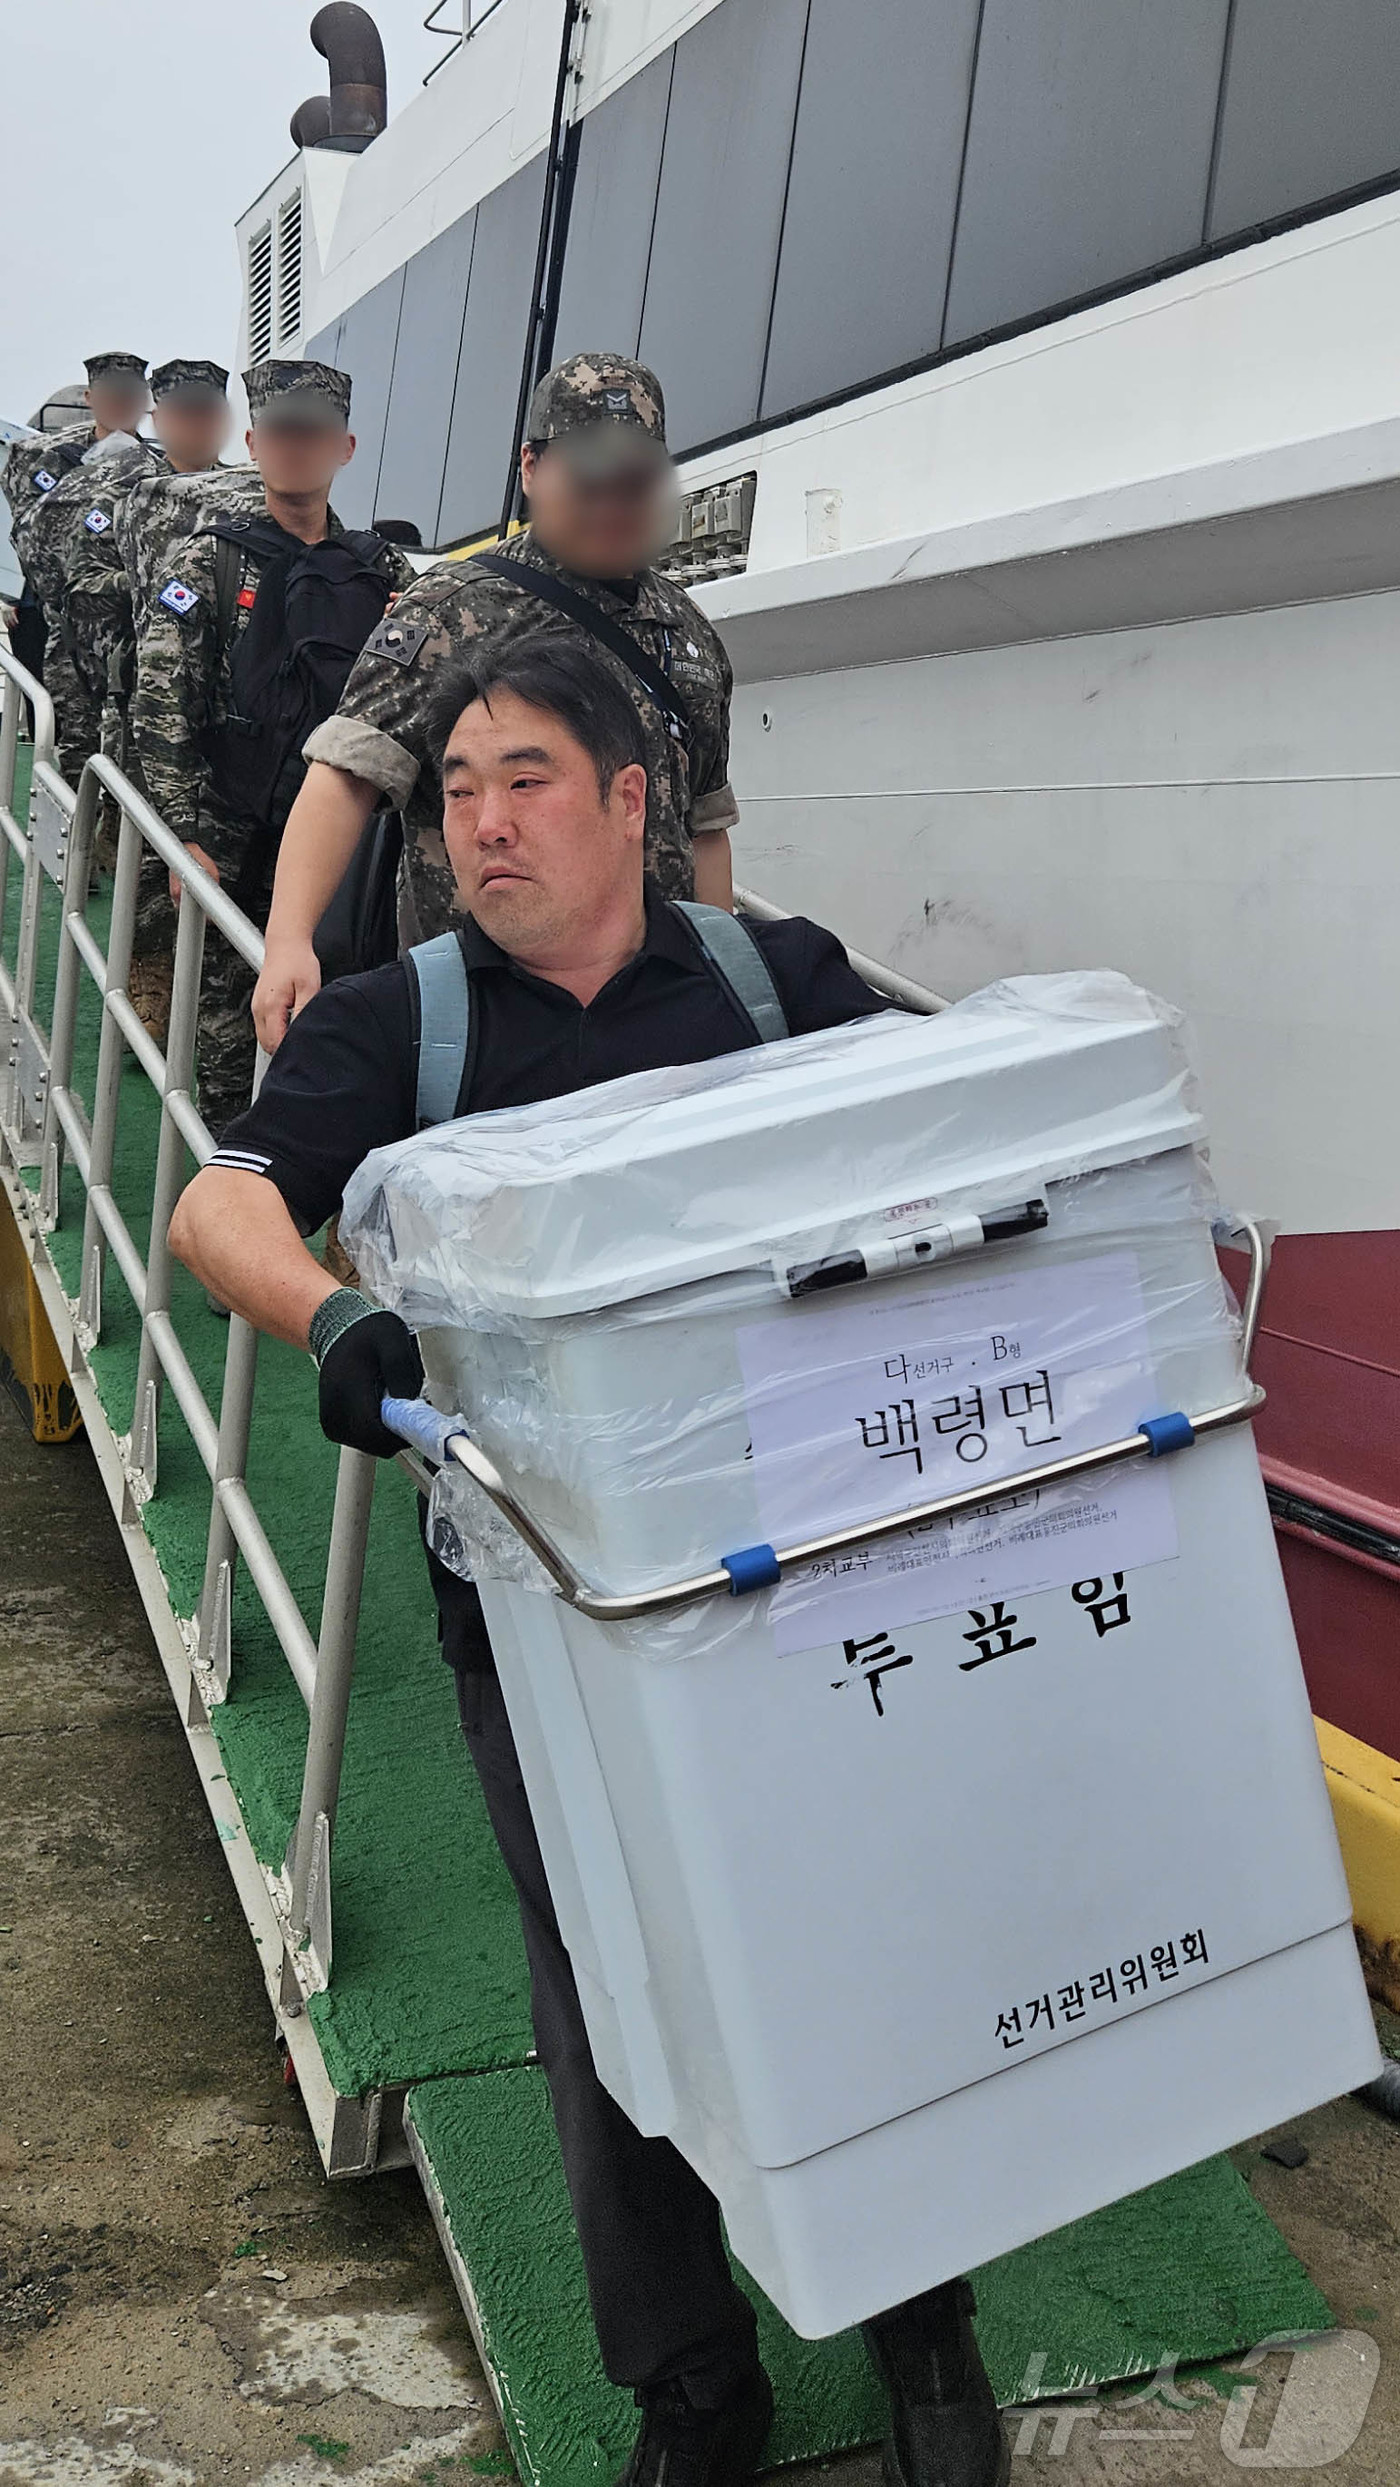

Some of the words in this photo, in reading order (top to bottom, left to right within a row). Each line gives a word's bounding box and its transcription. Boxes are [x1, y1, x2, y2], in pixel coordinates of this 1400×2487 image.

[884, 1354, 954, 1384] 다선거구
[990, 1335, 1021, 1361] B형
[854, 1369, 1062, 1475] 백령면
[993, 1928, 1211, 2050] 선거관리위원회
